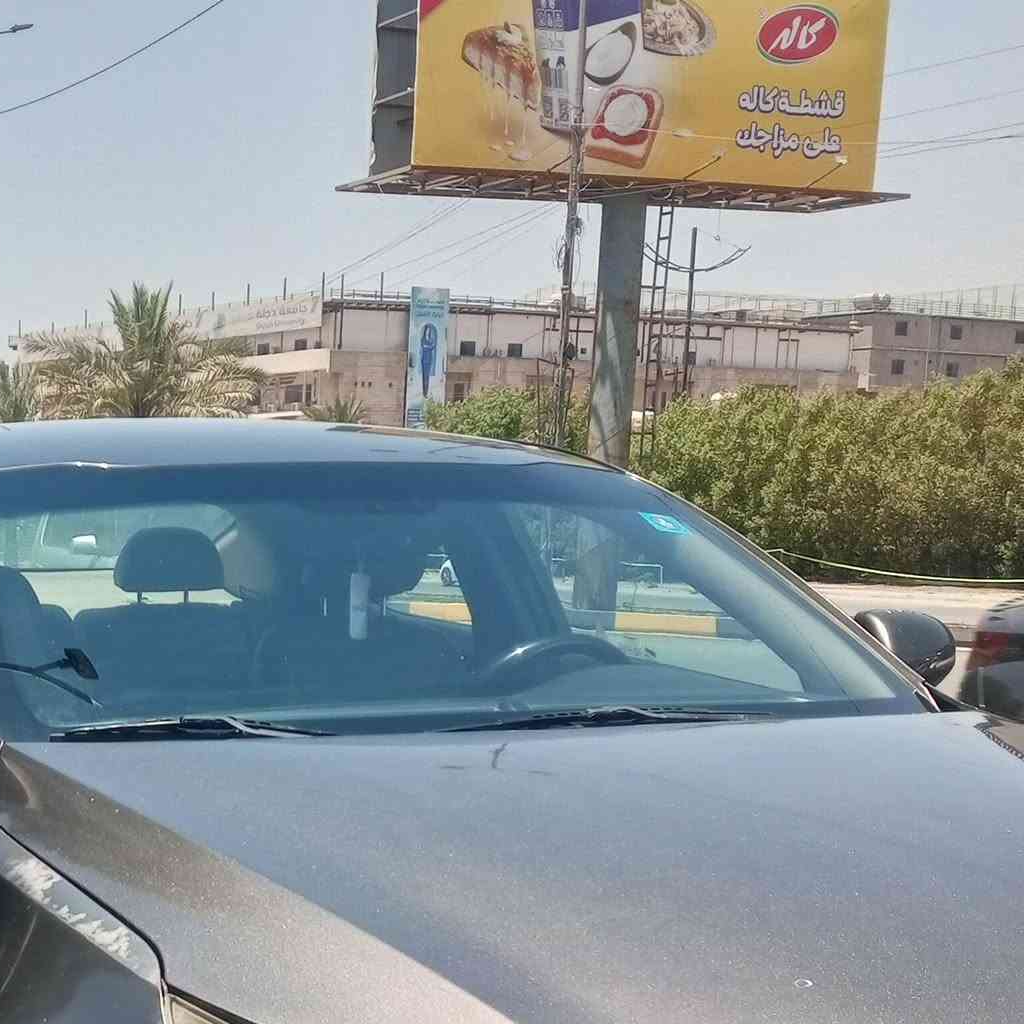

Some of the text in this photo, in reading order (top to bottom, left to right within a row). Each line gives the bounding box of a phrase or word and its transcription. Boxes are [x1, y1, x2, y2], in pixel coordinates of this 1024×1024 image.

[738, 85, 845, 118] قشطة كاله
[736, 120, 842, 159] على مزاجك
